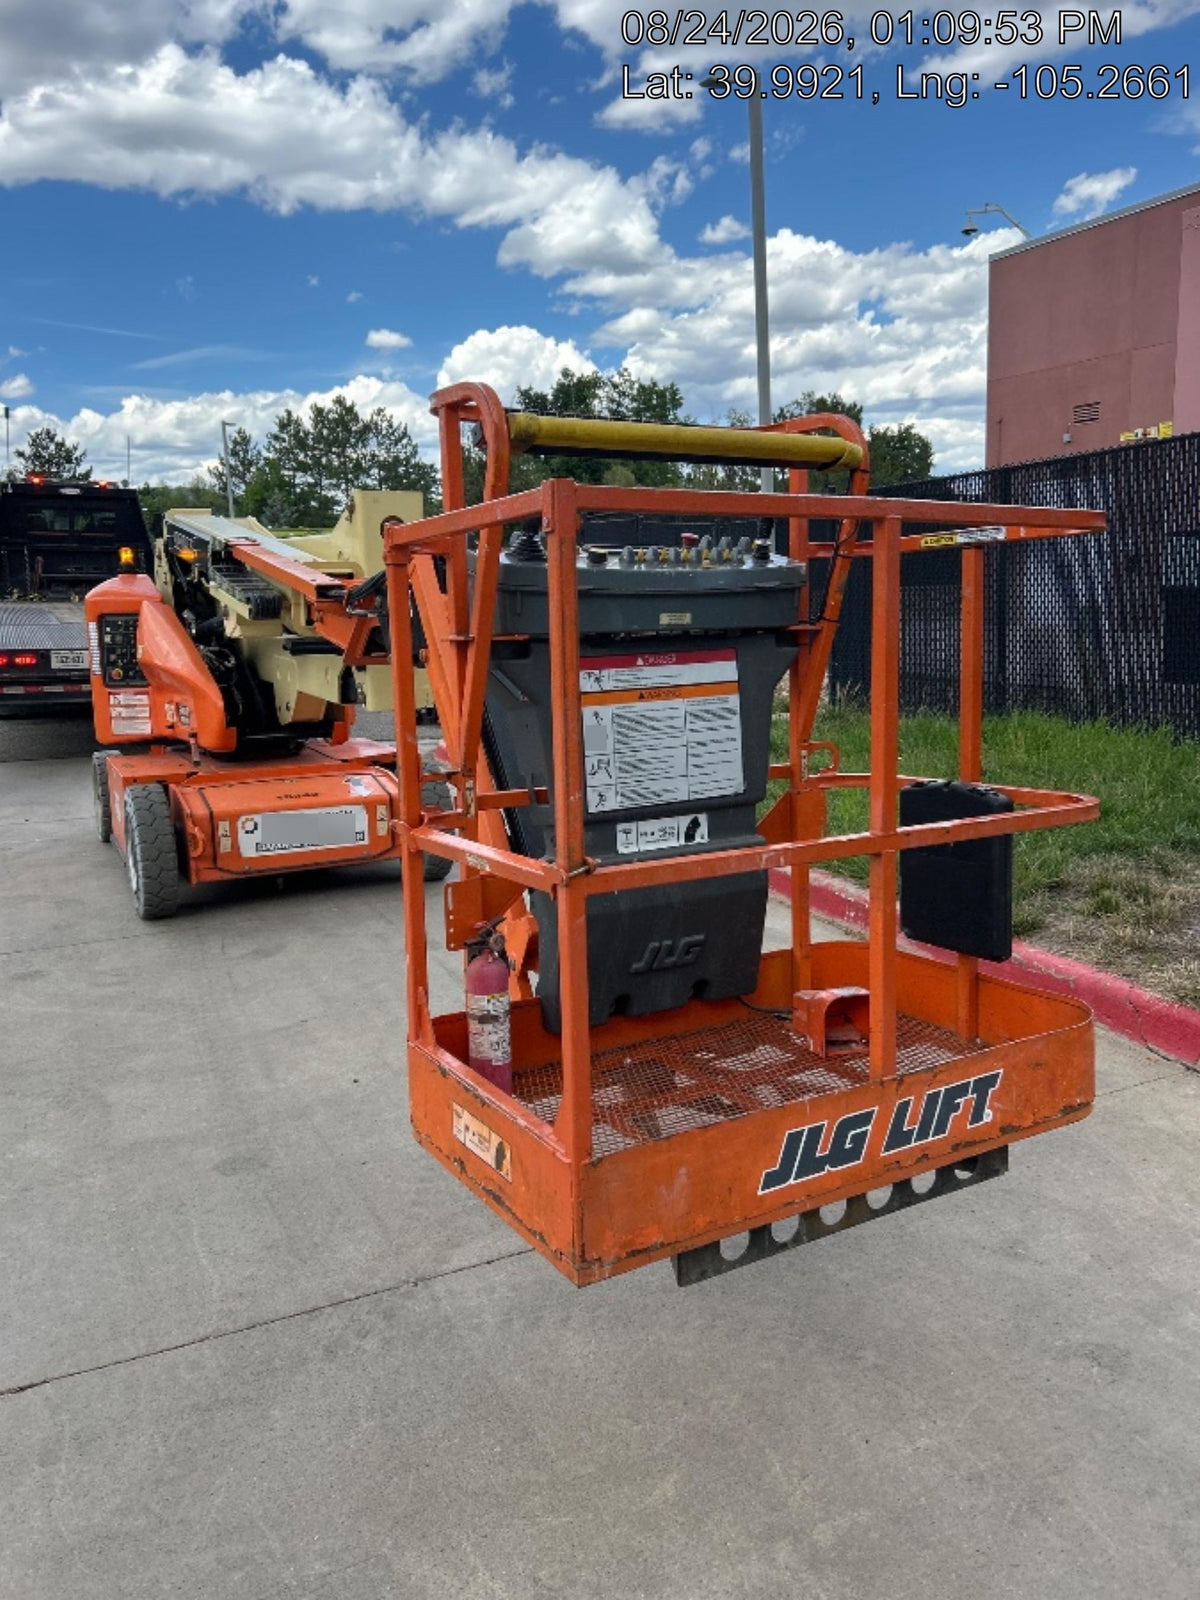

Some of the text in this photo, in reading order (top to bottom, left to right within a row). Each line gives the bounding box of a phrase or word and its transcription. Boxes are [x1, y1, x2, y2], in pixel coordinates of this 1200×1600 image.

[629, 934, 705, 974] JLG
[757, 1069, 1003, 1195] JLG LIFT
